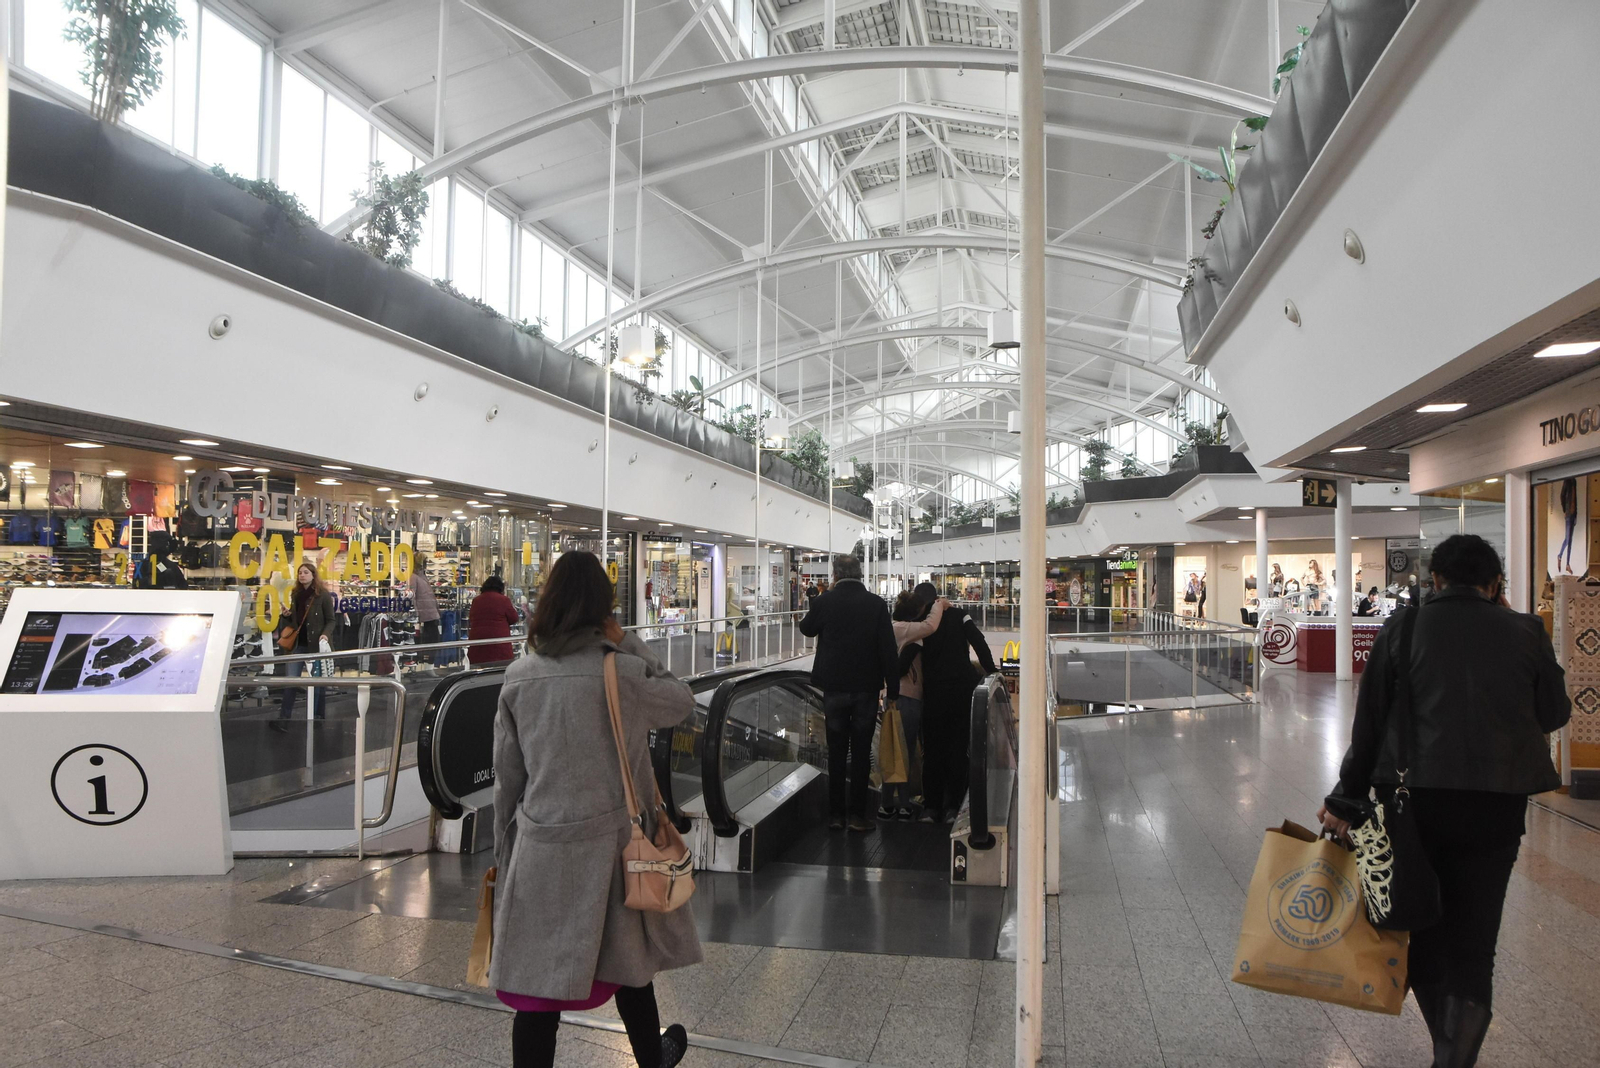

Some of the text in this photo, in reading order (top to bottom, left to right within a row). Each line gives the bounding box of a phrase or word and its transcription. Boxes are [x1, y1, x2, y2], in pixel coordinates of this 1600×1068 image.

[1540, 412, 1576, 447] TINO
[252, 490, 374, 529] DEPORTES
[331, 591, 414, 614] Descuento
[473, 768, 490, 784] LOCAL
[1277, 869, 1305, 890] SHAKING
[1288, 884, 1334, 923] 50
[1274, 918, 1301, 944] PRIMARK
